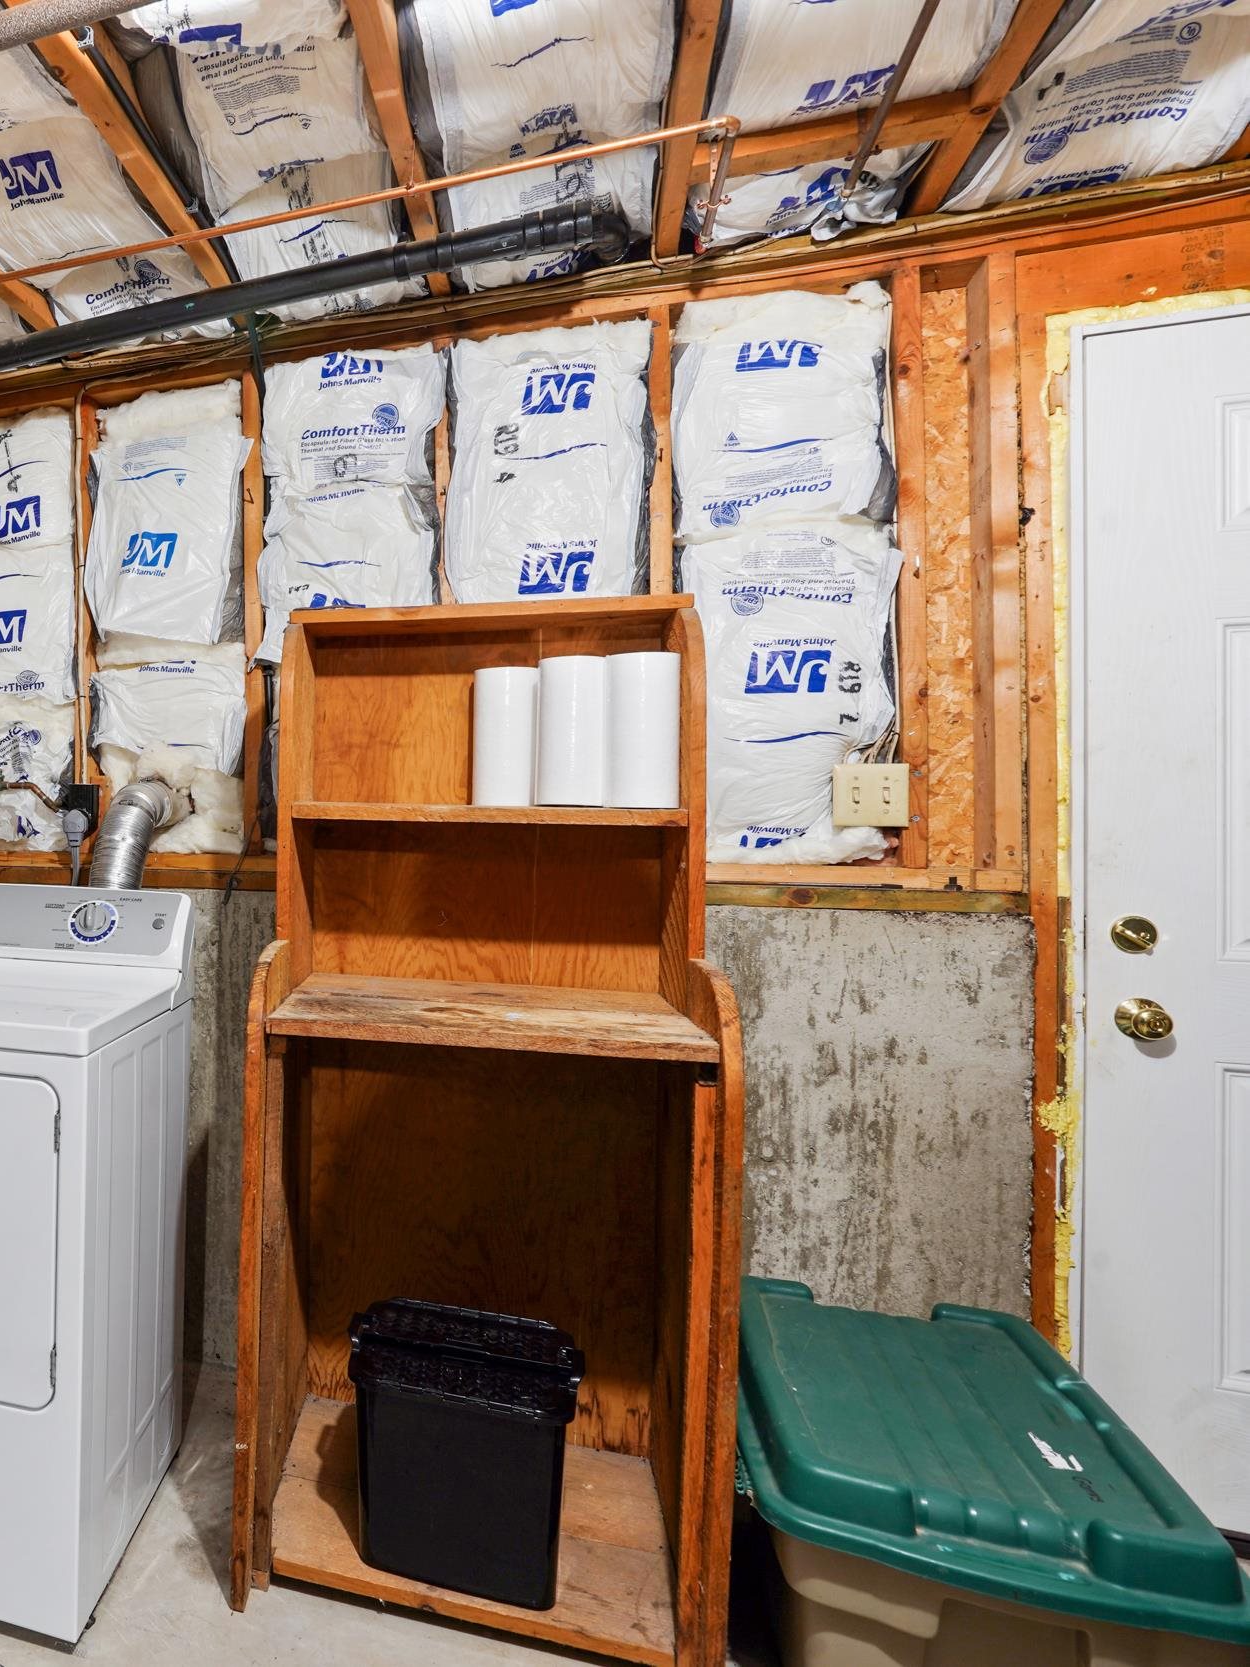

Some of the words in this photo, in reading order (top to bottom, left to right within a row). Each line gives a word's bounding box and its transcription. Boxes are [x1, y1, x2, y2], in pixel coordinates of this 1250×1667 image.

[223, 66, 238, 77] and
[735, 339, 823, 372] JM
[318, 380, 343, 391] Johns
[520, 373, 596, 416] JM
[702, 480, 832, 511] ComfortTherm
[10, 530, 41, 544] Manville
[121, 531, 178, 569] JM
[518, 551, 595, 595] JM
[802, 638, 837, 647] Johns
[139, 664, 160, 673] Johns
[160, 665, 195, 674] Manville
[744, 650, 832, 694] JM
[838, 660, 862, 694] R19
[746, 825, 791, 836] Manville
